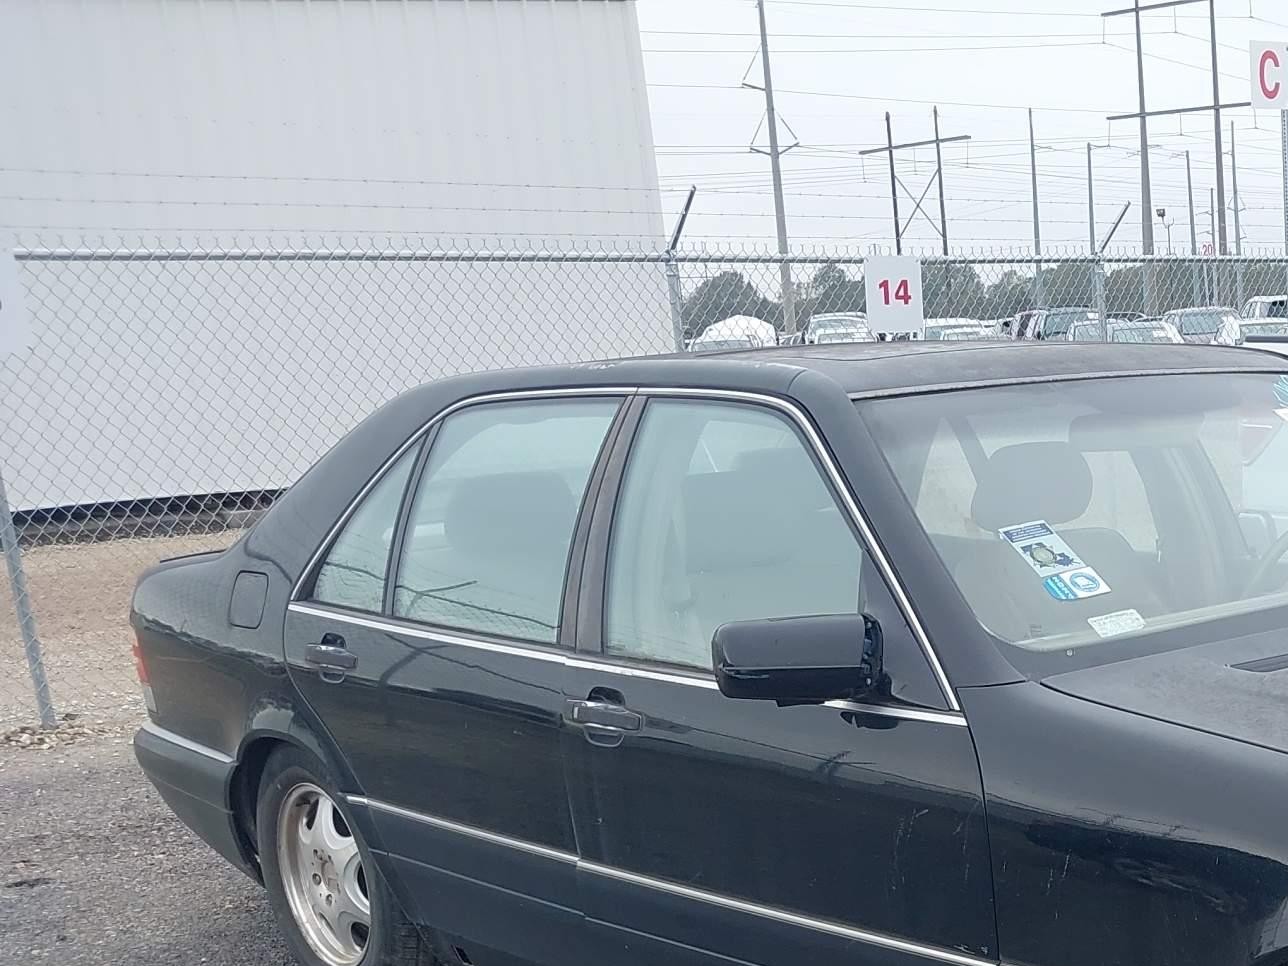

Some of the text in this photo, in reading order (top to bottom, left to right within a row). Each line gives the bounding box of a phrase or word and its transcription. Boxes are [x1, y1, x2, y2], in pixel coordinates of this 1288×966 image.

[1258, 49, 1281, 100] C
[1202, 243, 1213, 256] 20
[878, 279, 912, 305] 14
